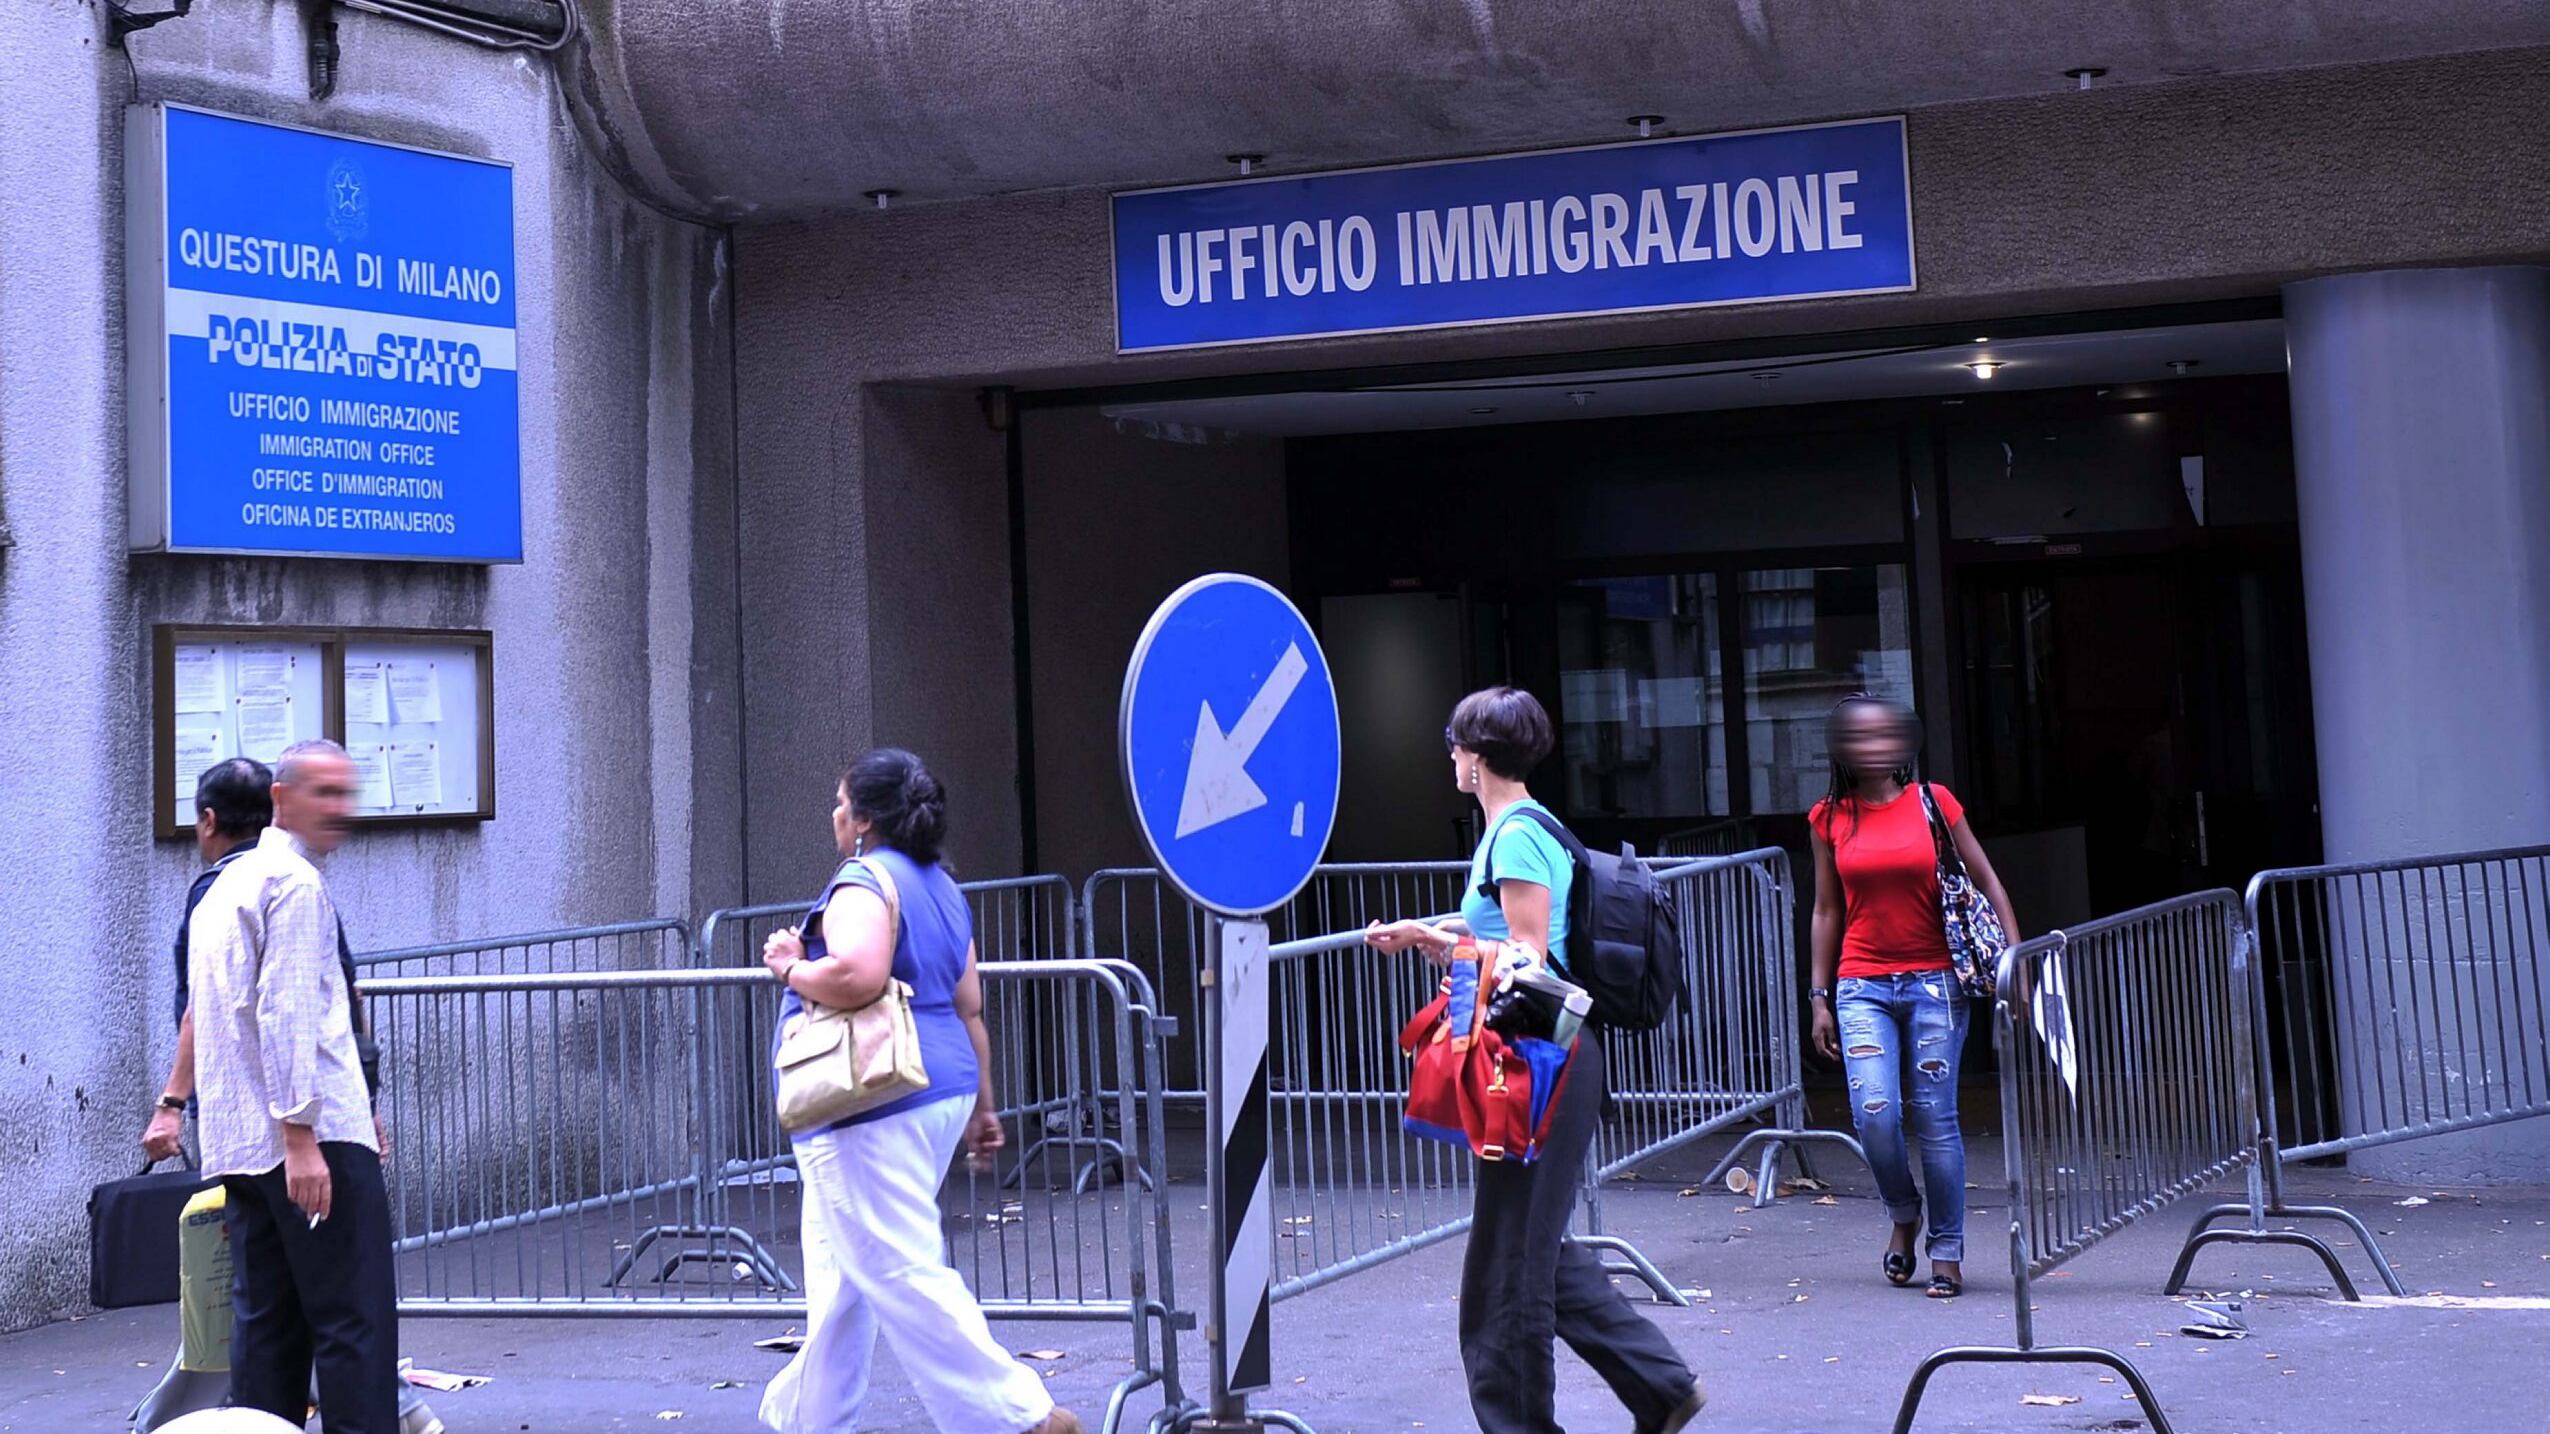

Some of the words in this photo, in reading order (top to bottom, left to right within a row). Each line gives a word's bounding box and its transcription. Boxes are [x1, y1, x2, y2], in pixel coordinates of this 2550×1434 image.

[1159, 215, 1377, 306] UFFICIO
[1397, 171, 1863, 286] IMMIGRAZIONE
[180, 227, 340, 284] QUESTURA
[357, 253, 382, 289] DI
[398, 259, 501, 304] MILANO
[208, 314, 352, 376] POLIZIA
[356, 353, 373, 378] DI
[376, 332, 482, 389] STATO
[229, 392, 310, 421] UFFICIO
[321, 400, 460, 435] IMMIGRAZIONE
[260, 434, 372, 461] IMMIGRATION
[380, 443, 435, 466] OFFICE
[252, 469, 313, 492] OFFICE
[322, 473, 443, 499] D'IMMIGRATION
[243, 504, 311, 526] OFICINA
[316, 507, 338, 528] DE
[343, 509, 455, 534] EXTRANJEROS
